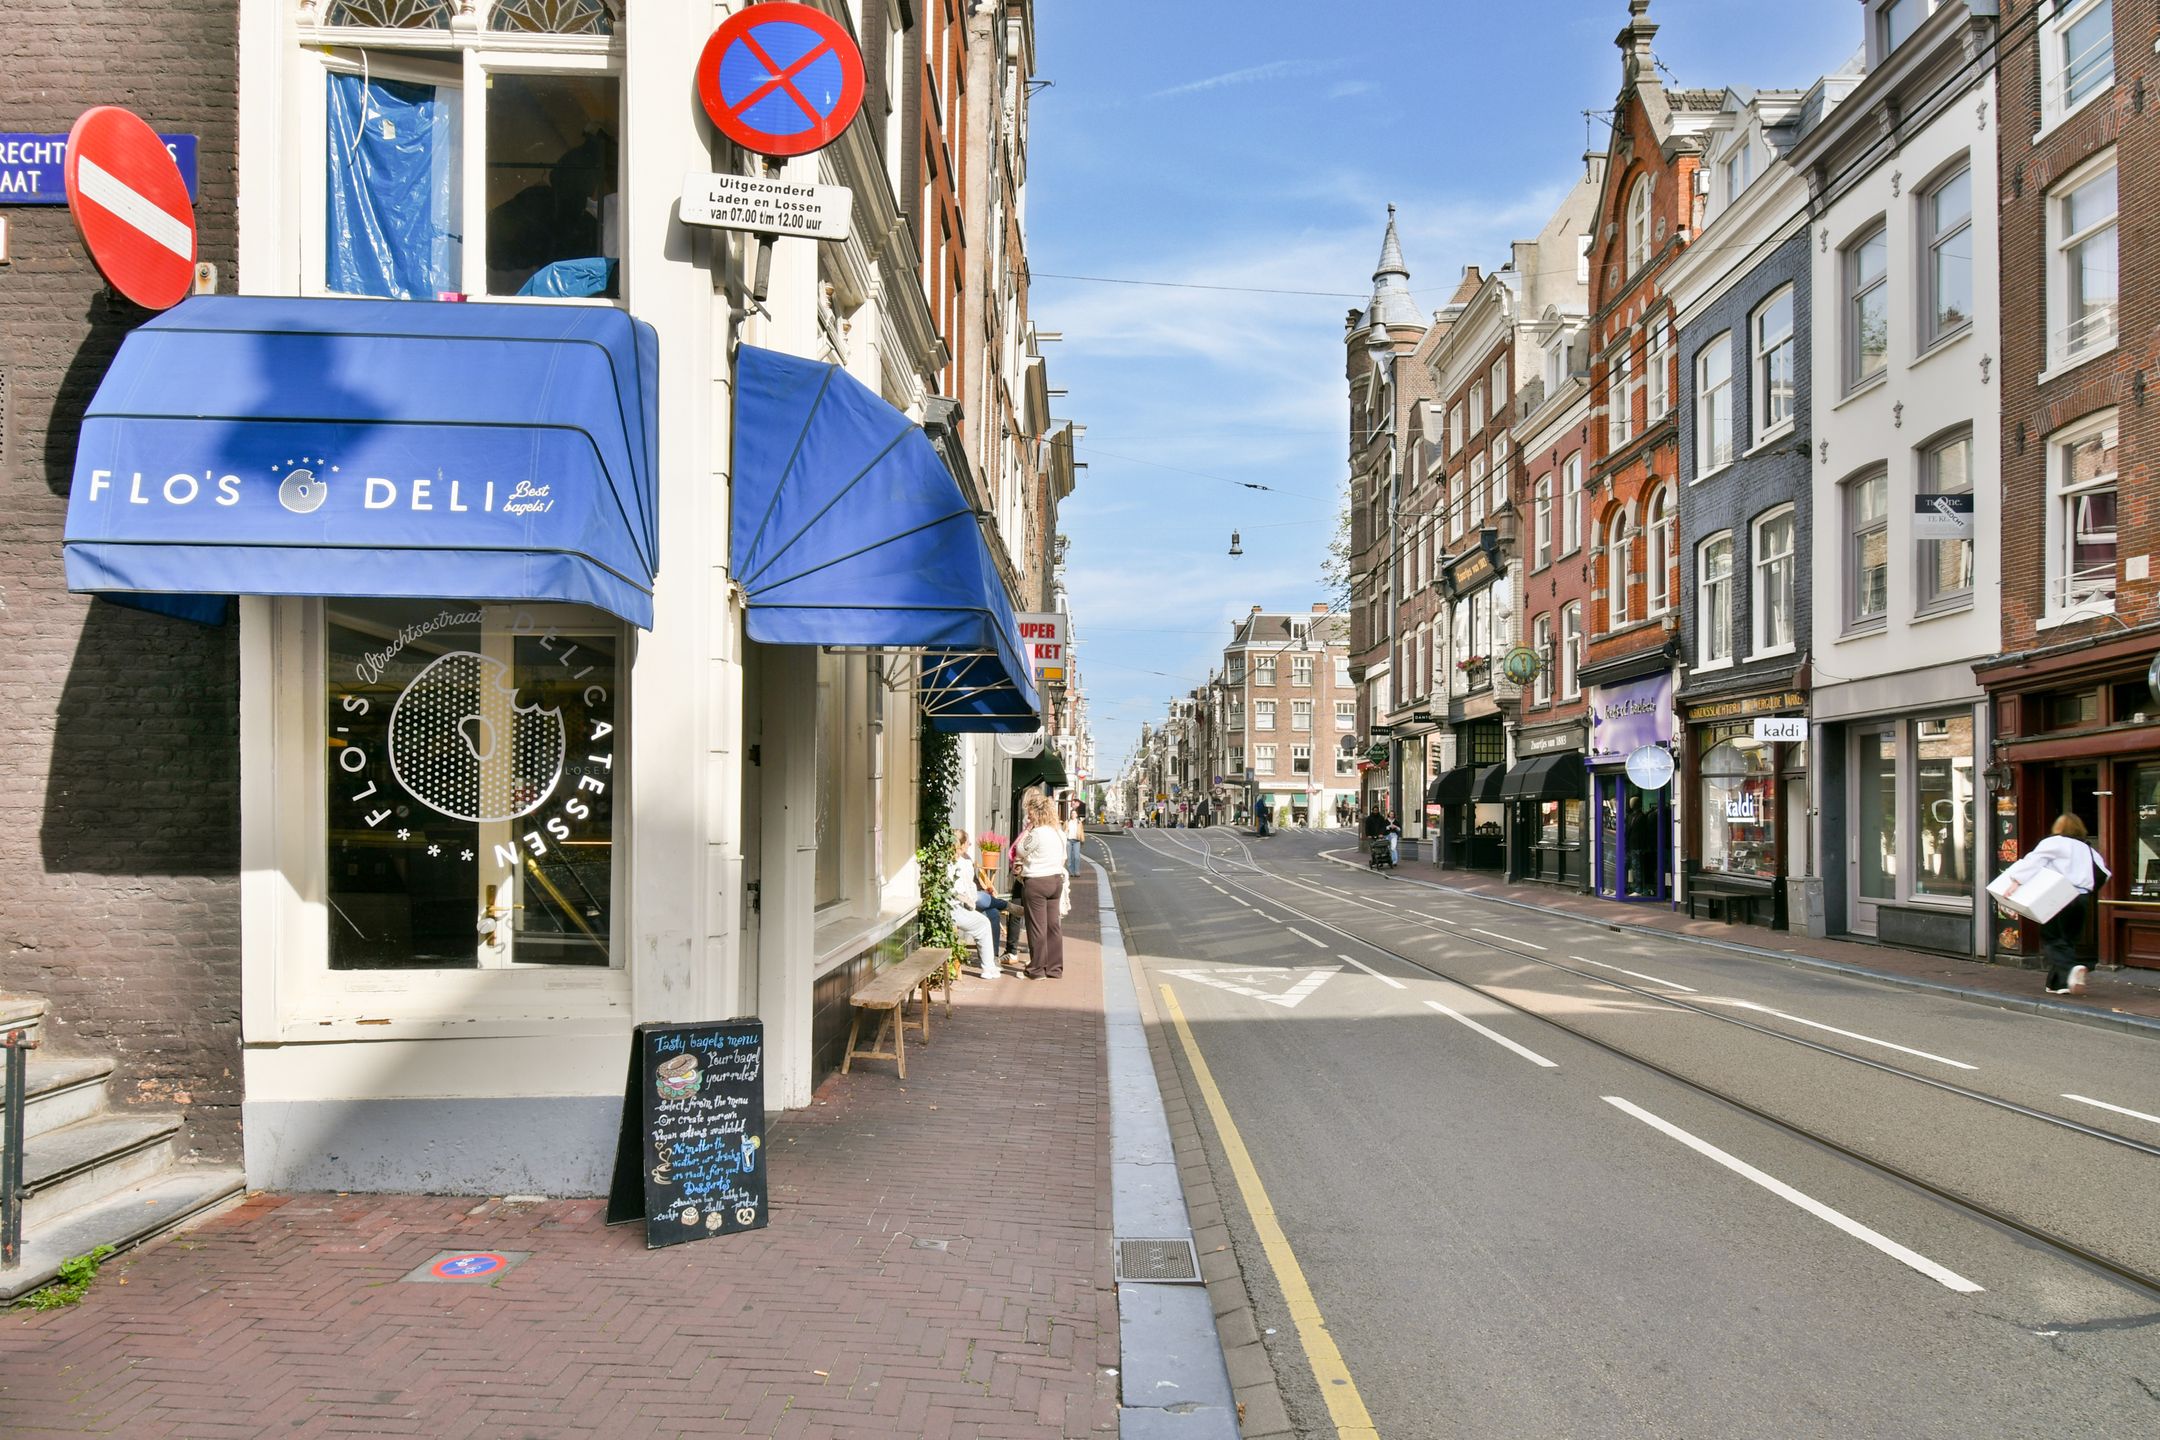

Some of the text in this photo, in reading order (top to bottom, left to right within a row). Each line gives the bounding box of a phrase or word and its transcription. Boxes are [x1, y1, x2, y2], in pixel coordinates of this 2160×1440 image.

[719, 178, 814, 197] Uitgezonderd
[709, 192, 822, 213] Laden en Lossen
[711, 207, 822, 231] van 07.00 t/m 12.00 uur
[89, 469, 494, 512] FLO'S DELI
[508, 480, 550, 500] Best
[502, 499, 555, 516] bagels!
[1937, 500, 1964, 527] VERKOCHT
[1018, 623, 1055, 638] UPER
[356, 609, 487, 686] Utrechtsestraat
[493, 611, 613, 868] DELICATESSEN
[1764, 723, 1799, 737] kaldi
[1547, 739, 1555, 747] van
[1725, 791, 1754, 817] kaldi
[654, 1032, 759, 1054] Tasty bagels menu
[707, 1047, 761, 1069] Your bagel
[684, 1096, 712, 1113] from
[713, 1095, 726, 1108] the
[727, 1096, 748, 1108] menu
[677, 1110, 704, 1124] create
[706, 1113, 724, 1125] your
[723, 1111, 737, 1120] own
[652, 1129, 677, 1144] Vegan
[679, 1124, 707, 1141] options
[685, 1139, 713, 1154] matter
[714, 1137, 725, 1149] the
[705, 1164, 724, 1180] for
[683, 1176, 731, 1195] Desserts
